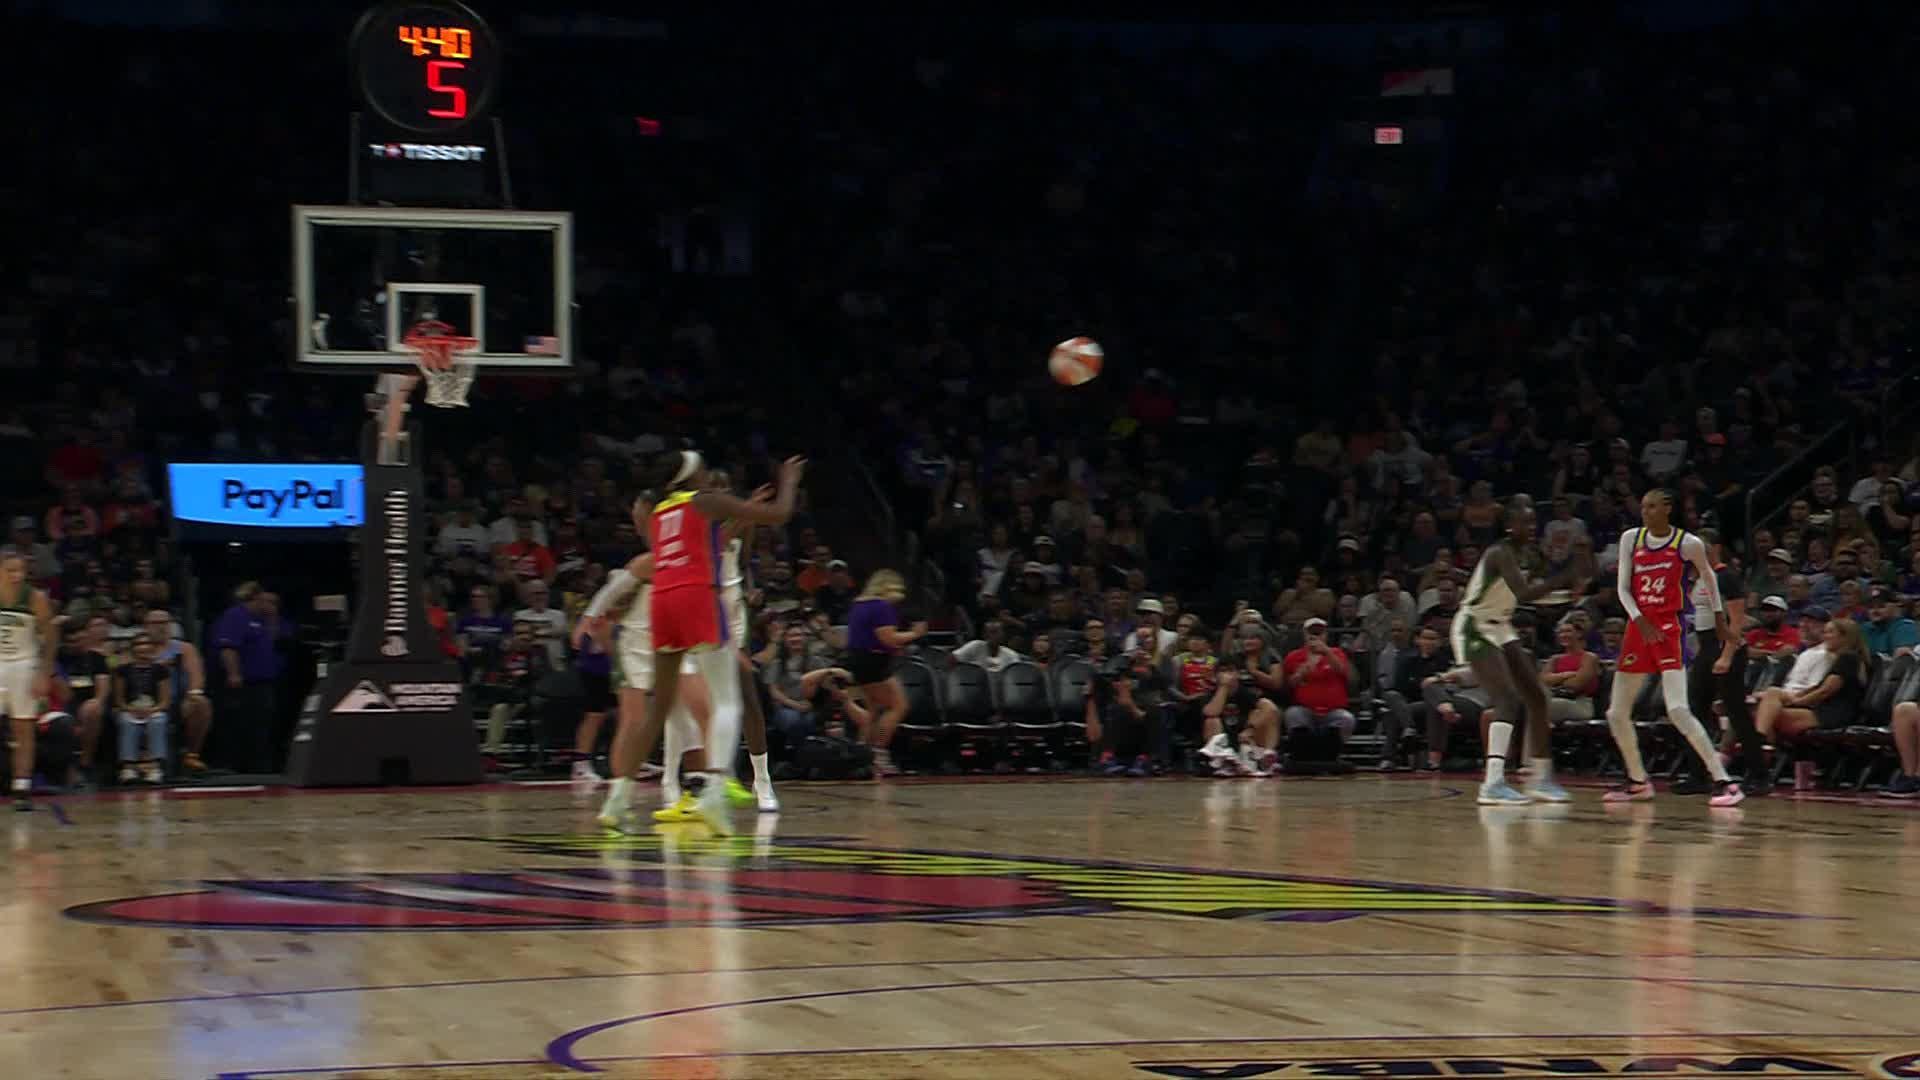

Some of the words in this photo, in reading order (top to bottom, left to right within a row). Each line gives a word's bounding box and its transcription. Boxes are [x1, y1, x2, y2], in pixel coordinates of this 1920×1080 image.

[427, 60, 467, 118] 5
[400, 144, 486, 160] TISSOT
[222, 479, 344, 518] PayPal
[1640, 575, 1666, 594] 24
[1134, 1058, 1853, 1078] WNBA
